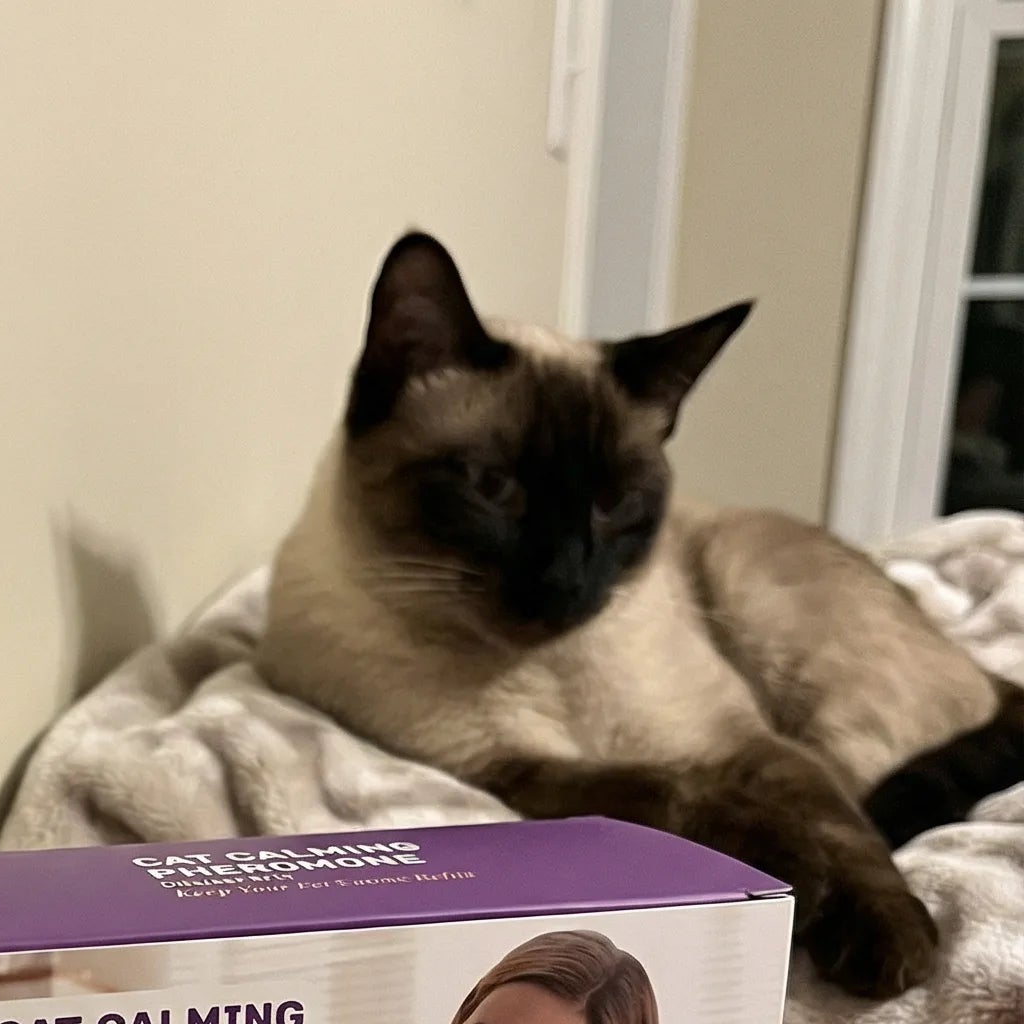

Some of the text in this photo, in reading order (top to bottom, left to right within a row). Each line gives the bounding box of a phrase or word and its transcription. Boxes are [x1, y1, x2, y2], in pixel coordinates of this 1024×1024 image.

[132, 841, 422, 868] CAT CALMING
[147, 853, 427, 880] PHEROMONE
